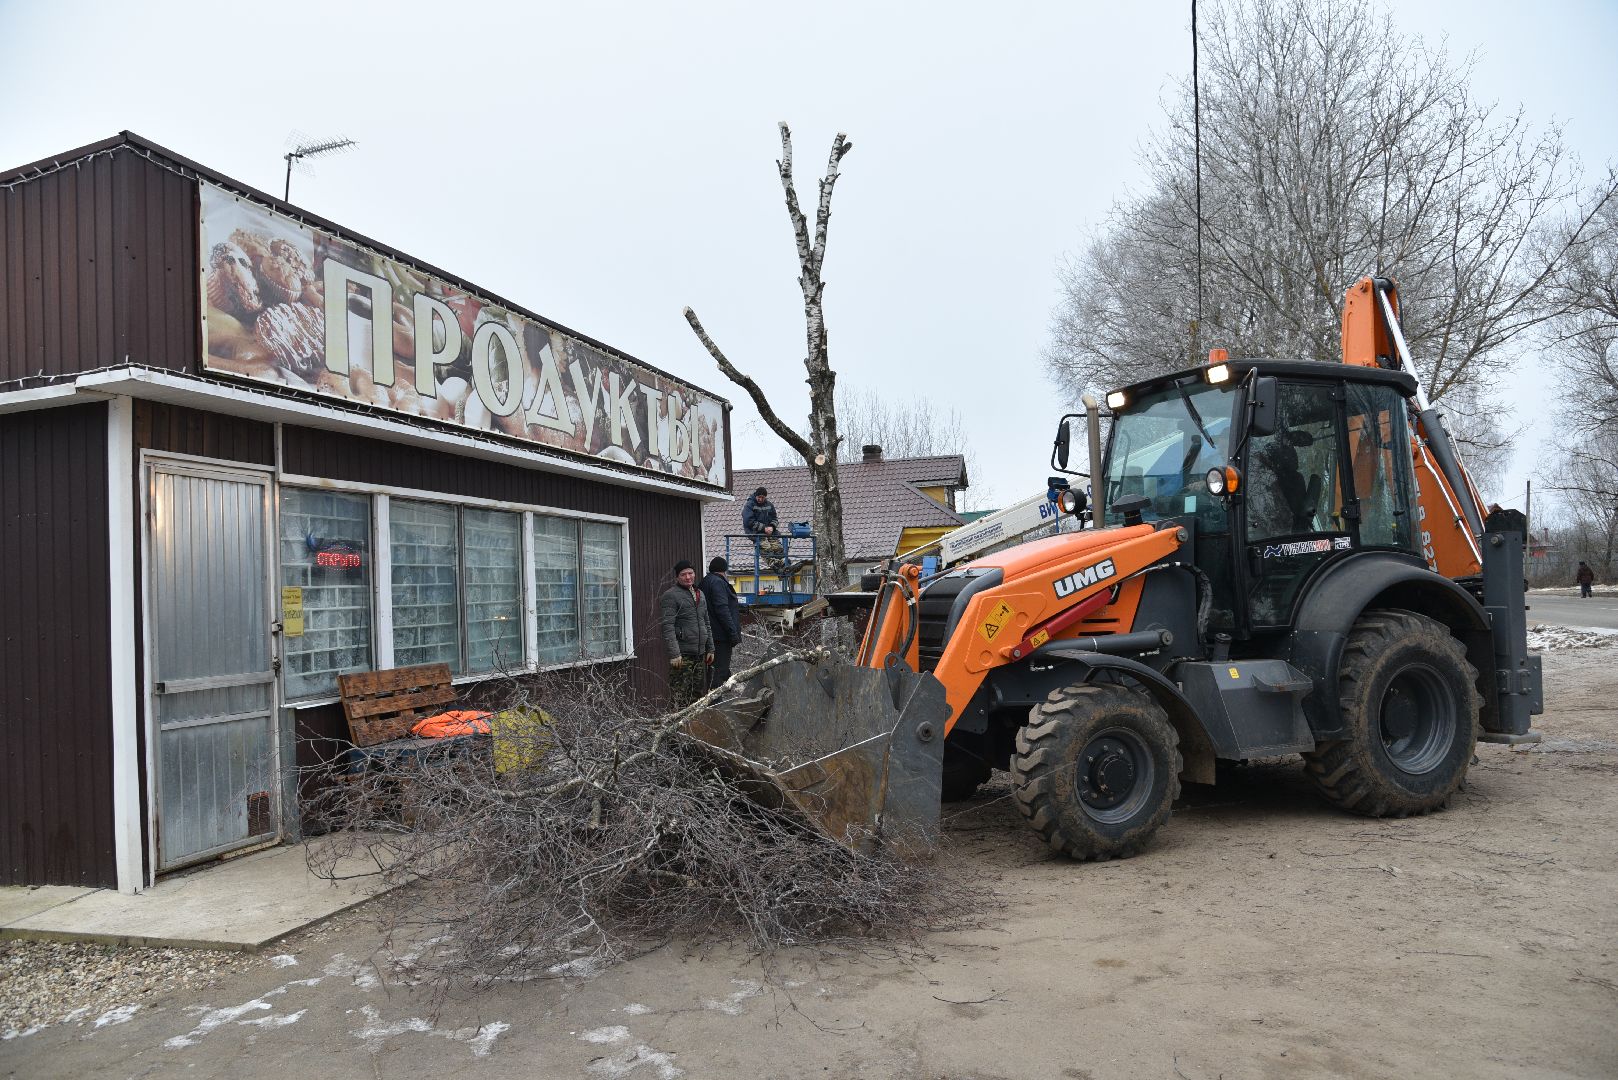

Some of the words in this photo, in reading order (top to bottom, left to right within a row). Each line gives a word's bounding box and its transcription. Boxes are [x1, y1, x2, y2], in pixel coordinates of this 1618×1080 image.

[323, 257, 702, 468] ПРОДУКТЫ
[317, 552, 360, 567] ОТКРЫТО
[1054, 559, 1115, 597] UMG
